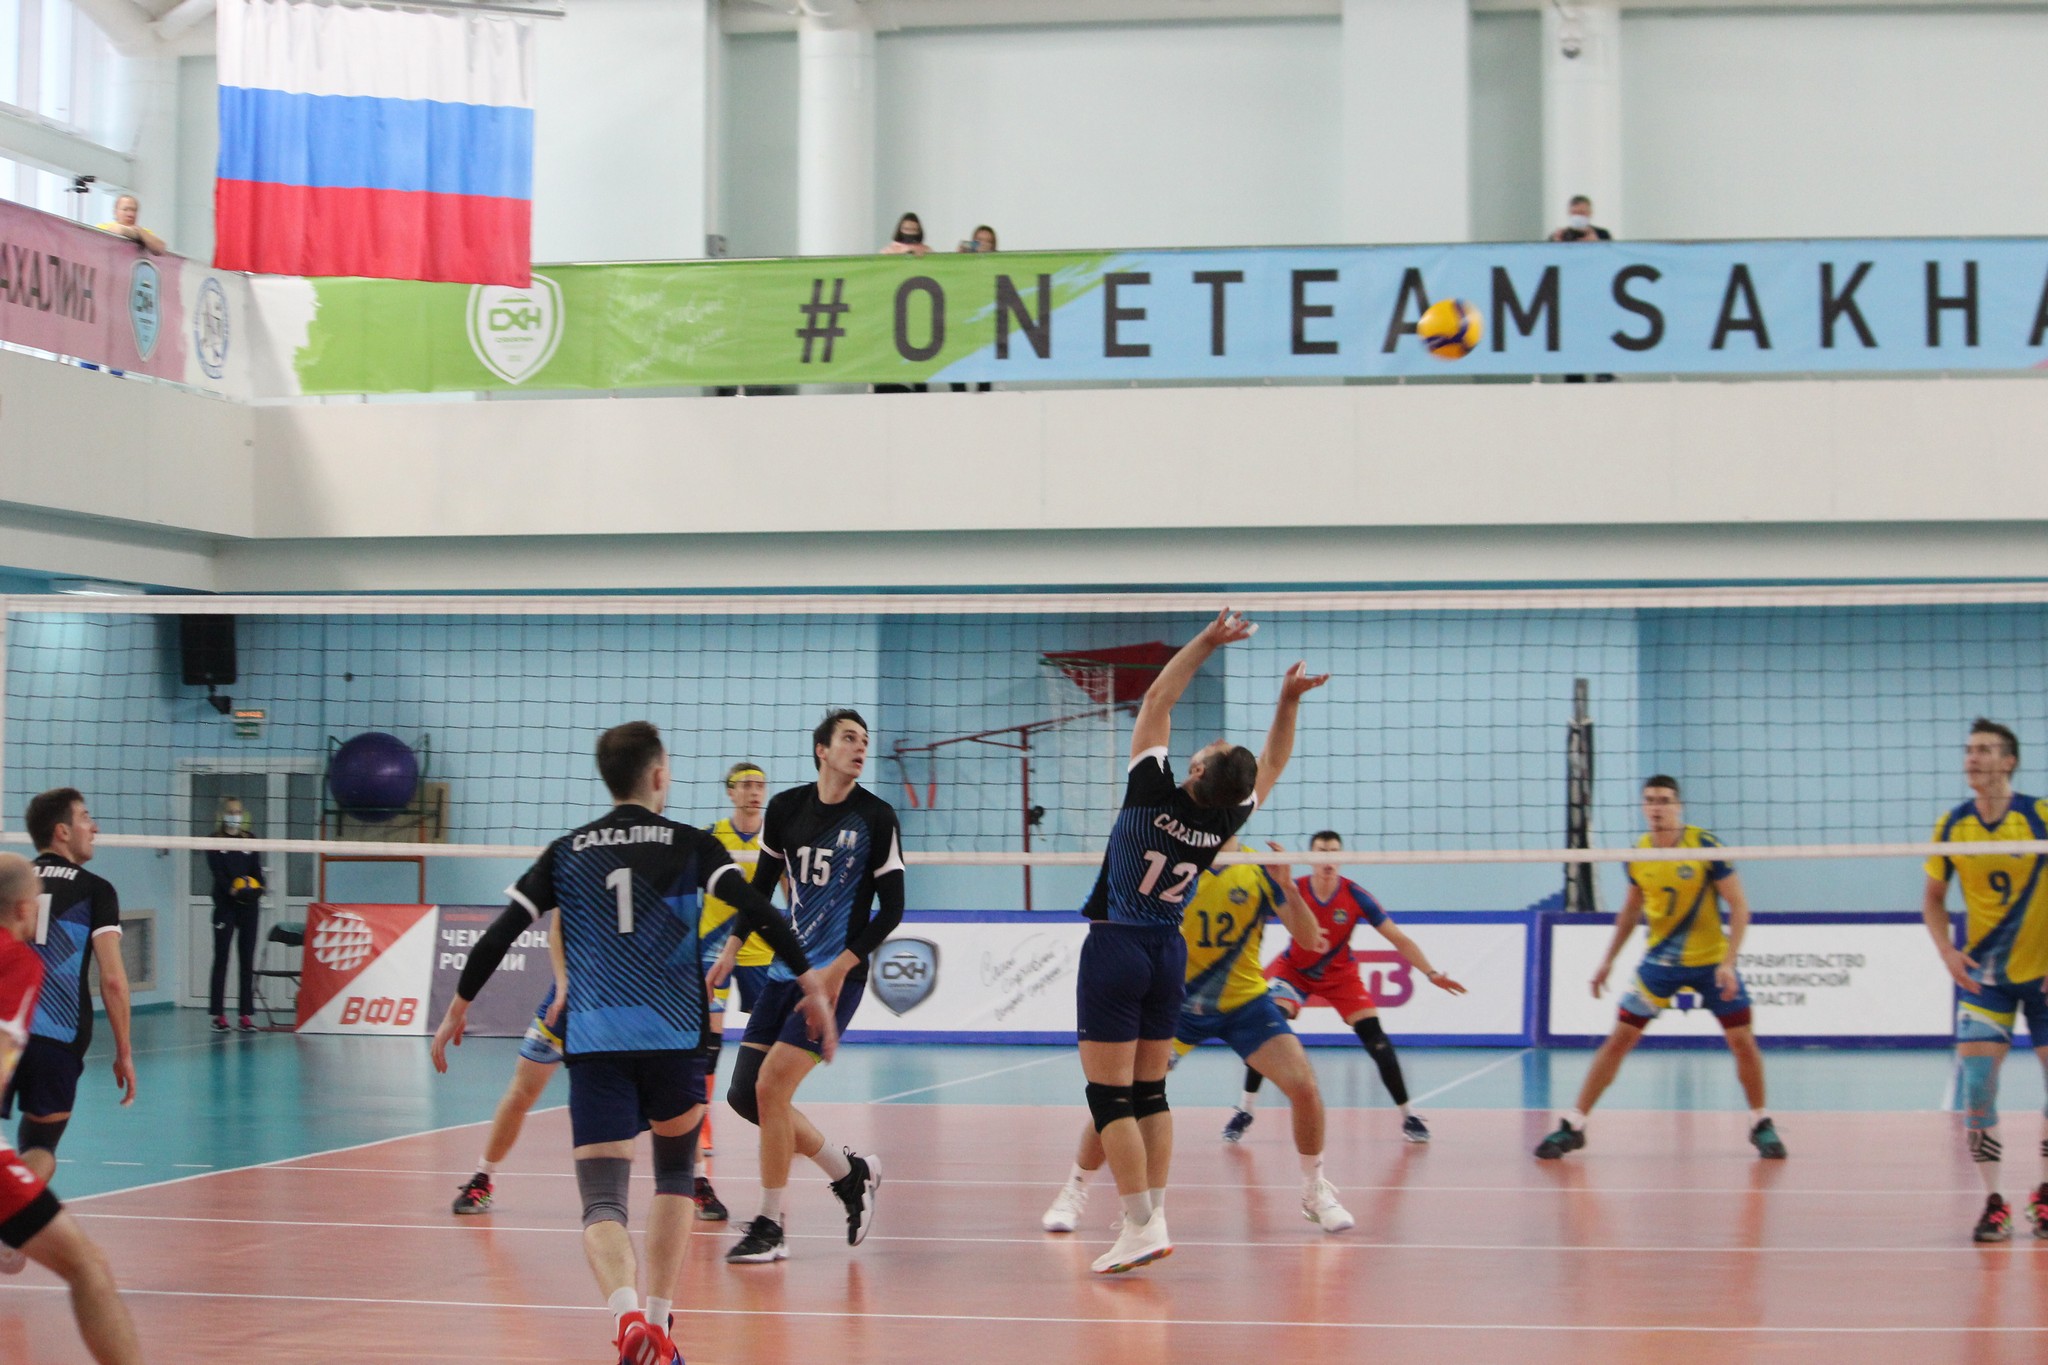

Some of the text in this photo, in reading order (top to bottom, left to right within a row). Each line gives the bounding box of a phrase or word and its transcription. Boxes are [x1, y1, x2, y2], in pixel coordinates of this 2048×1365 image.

[572, 825, 674, 852] САХАЛИН
[796, 845, 834, 887] 15
[1138, 849, 1198, 903] 12
[605, 867, 634, 934] 1
[1661, 886, 1678, 917] 7
[1988, 870, 2011, 906] 9
[1196, 909, 1236, 948] 12
[1743, 969, 1851, 987] АХАЛИНСКОЙ
[339, 996, 418, 1026] ВФВ
